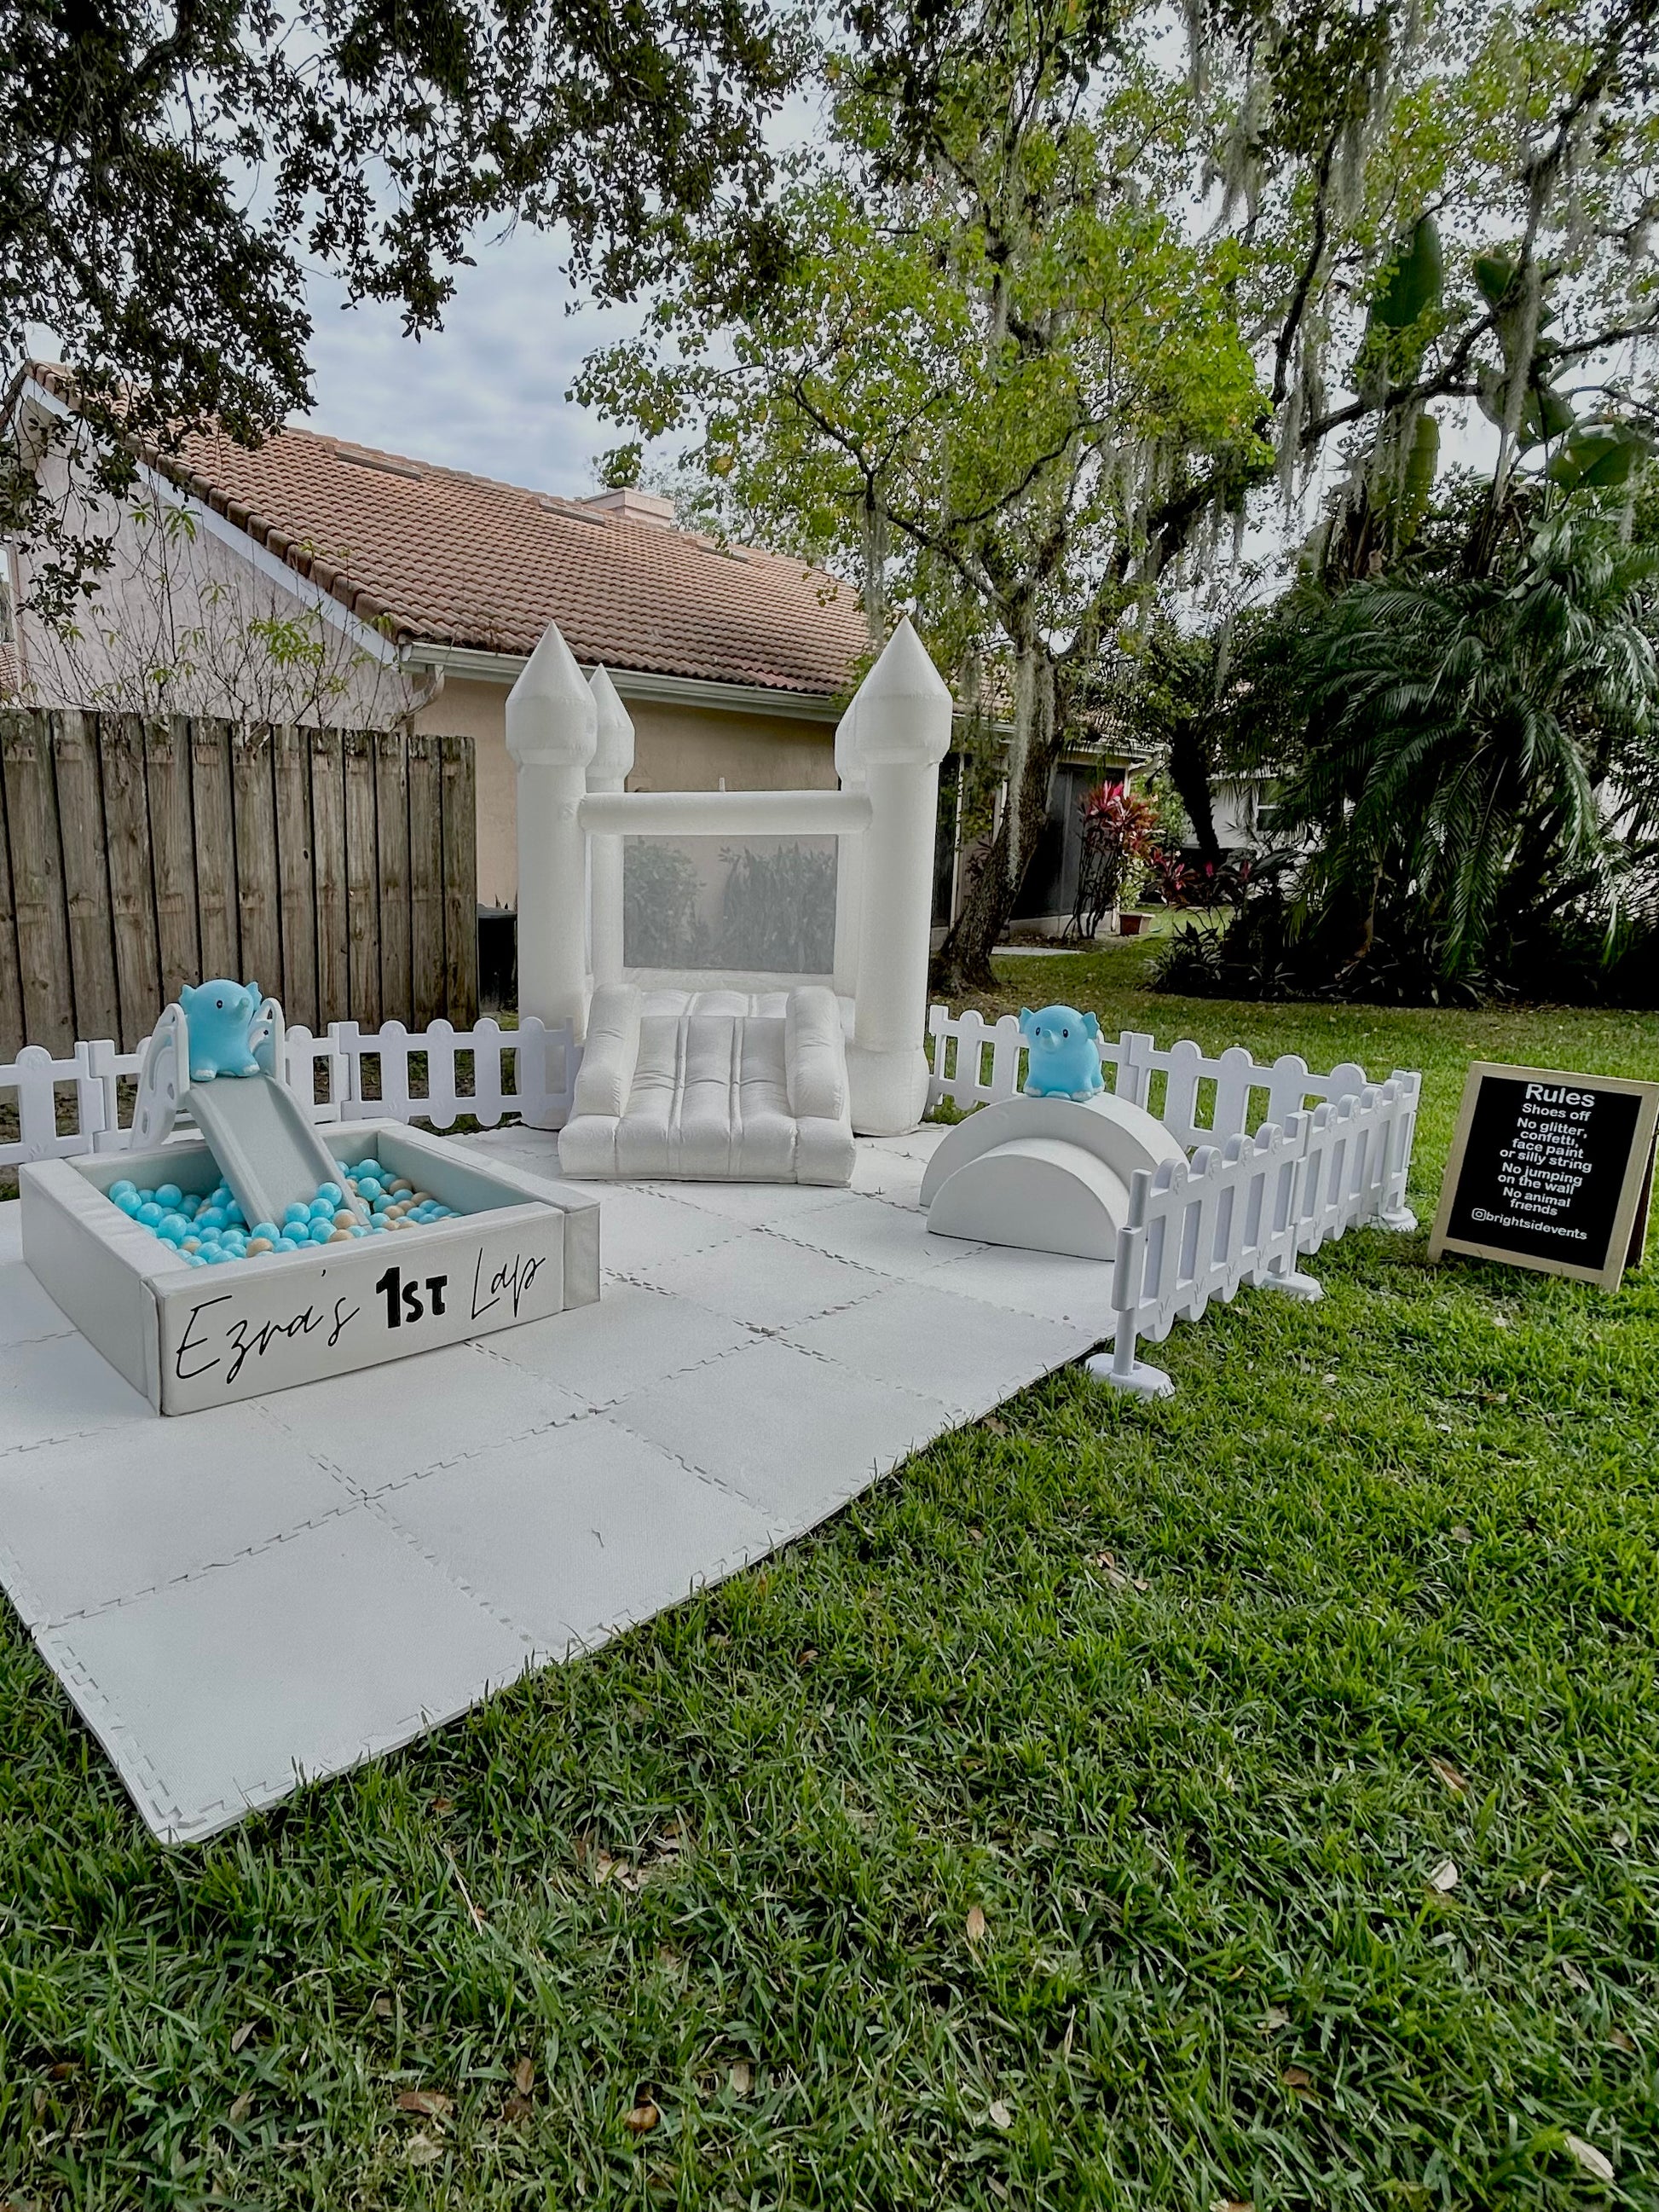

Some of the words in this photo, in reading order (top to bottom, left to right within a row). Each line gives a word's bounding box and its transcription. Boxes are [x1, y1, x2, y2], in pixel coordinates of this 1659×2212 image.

[1525, 1083, 1595, 1108] Rules
[1522, 1103, 1566, 1119] Shoes
[1569, 1110, 1592, 1121] off
[1517, 1117, 1536, 1130] No
[1540, 1121, 1587, 1138] glitter,
[1512, 1138, 1543, 1152] face
[1546, 1144, 1584, 1159] paint
[1520, 1131, 1579, 1148] confetti,
[1500, 1149, 1515, 1158] or
[1517, 1150, 1546, 1166] silly
[1548, 1155, 1593, 1173] string
[1497, 1174, 1515, 1184] on
[1518, 1176, 1541, 1189] the
[1545, 1182, 1575, 1195] wall
[1501, 1162, 1522, 1175] No
[1523, 1166, 1582, 1187] jumping
[1503, 1187, 1522, 1198] No
[1523, 1192, 1571, 1208] animal
[1510, 1198, 1558, 1216] friends
[176, 1269, 361, 1384] Ezra's
[375, 1266, 448, 1329] 1ST
[471, 1247, 546, 1319] Lap
